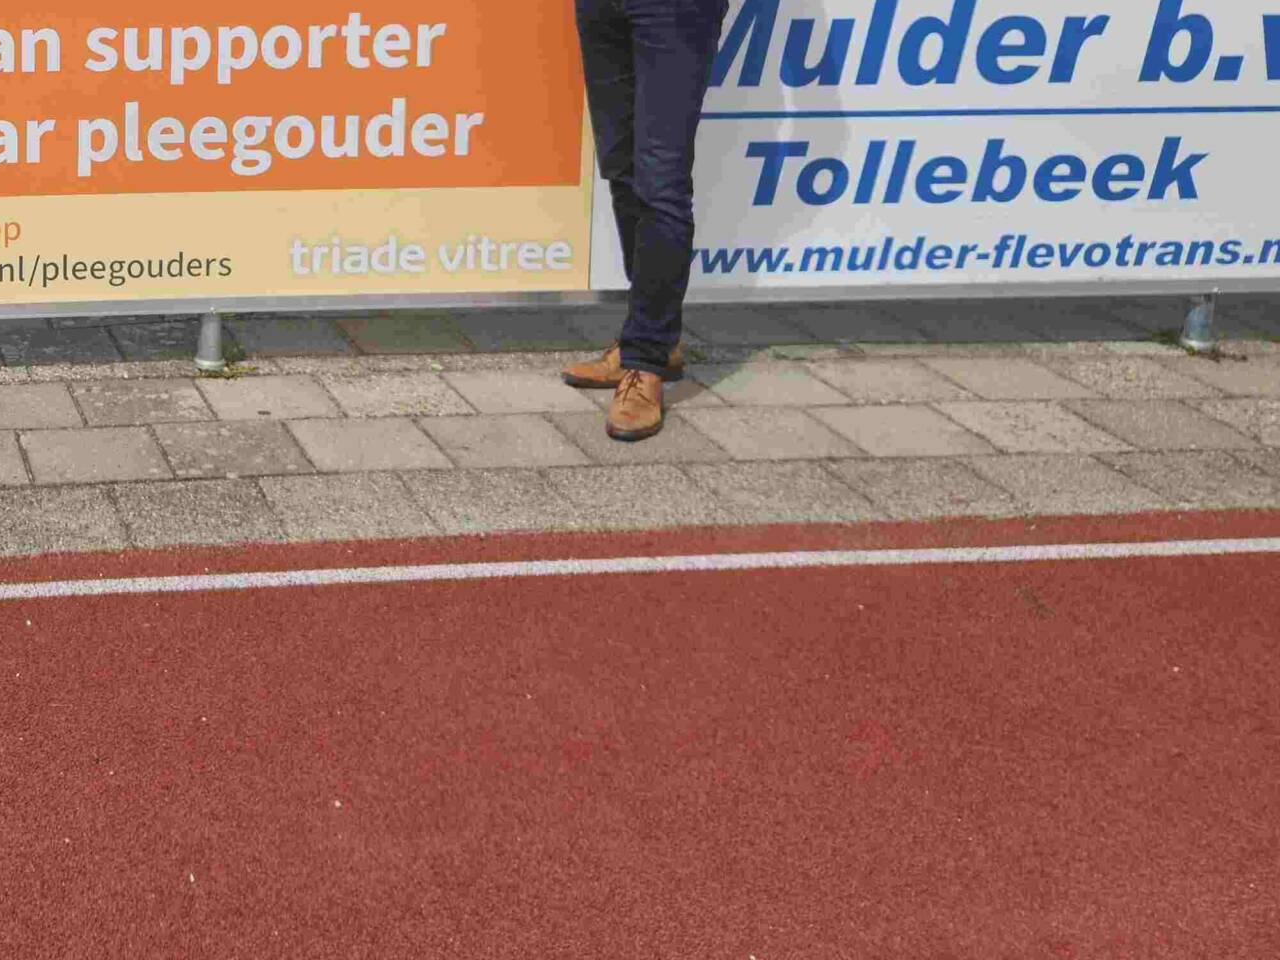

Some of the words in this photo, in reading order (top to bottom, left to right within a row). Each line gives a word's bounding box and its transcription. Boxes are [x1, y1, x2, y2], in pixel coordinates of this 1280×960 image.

[84, 12, 447, 85] supporter
[77, 97, 485, 177] pleegouder
[745, 136, 1210, 206] Tollebeek
[289, 235, 425, 275] triade
[437, 233, 572, 272] vitree
[691, 234, 1280, 274] ww.mulder-flevotrans.n
